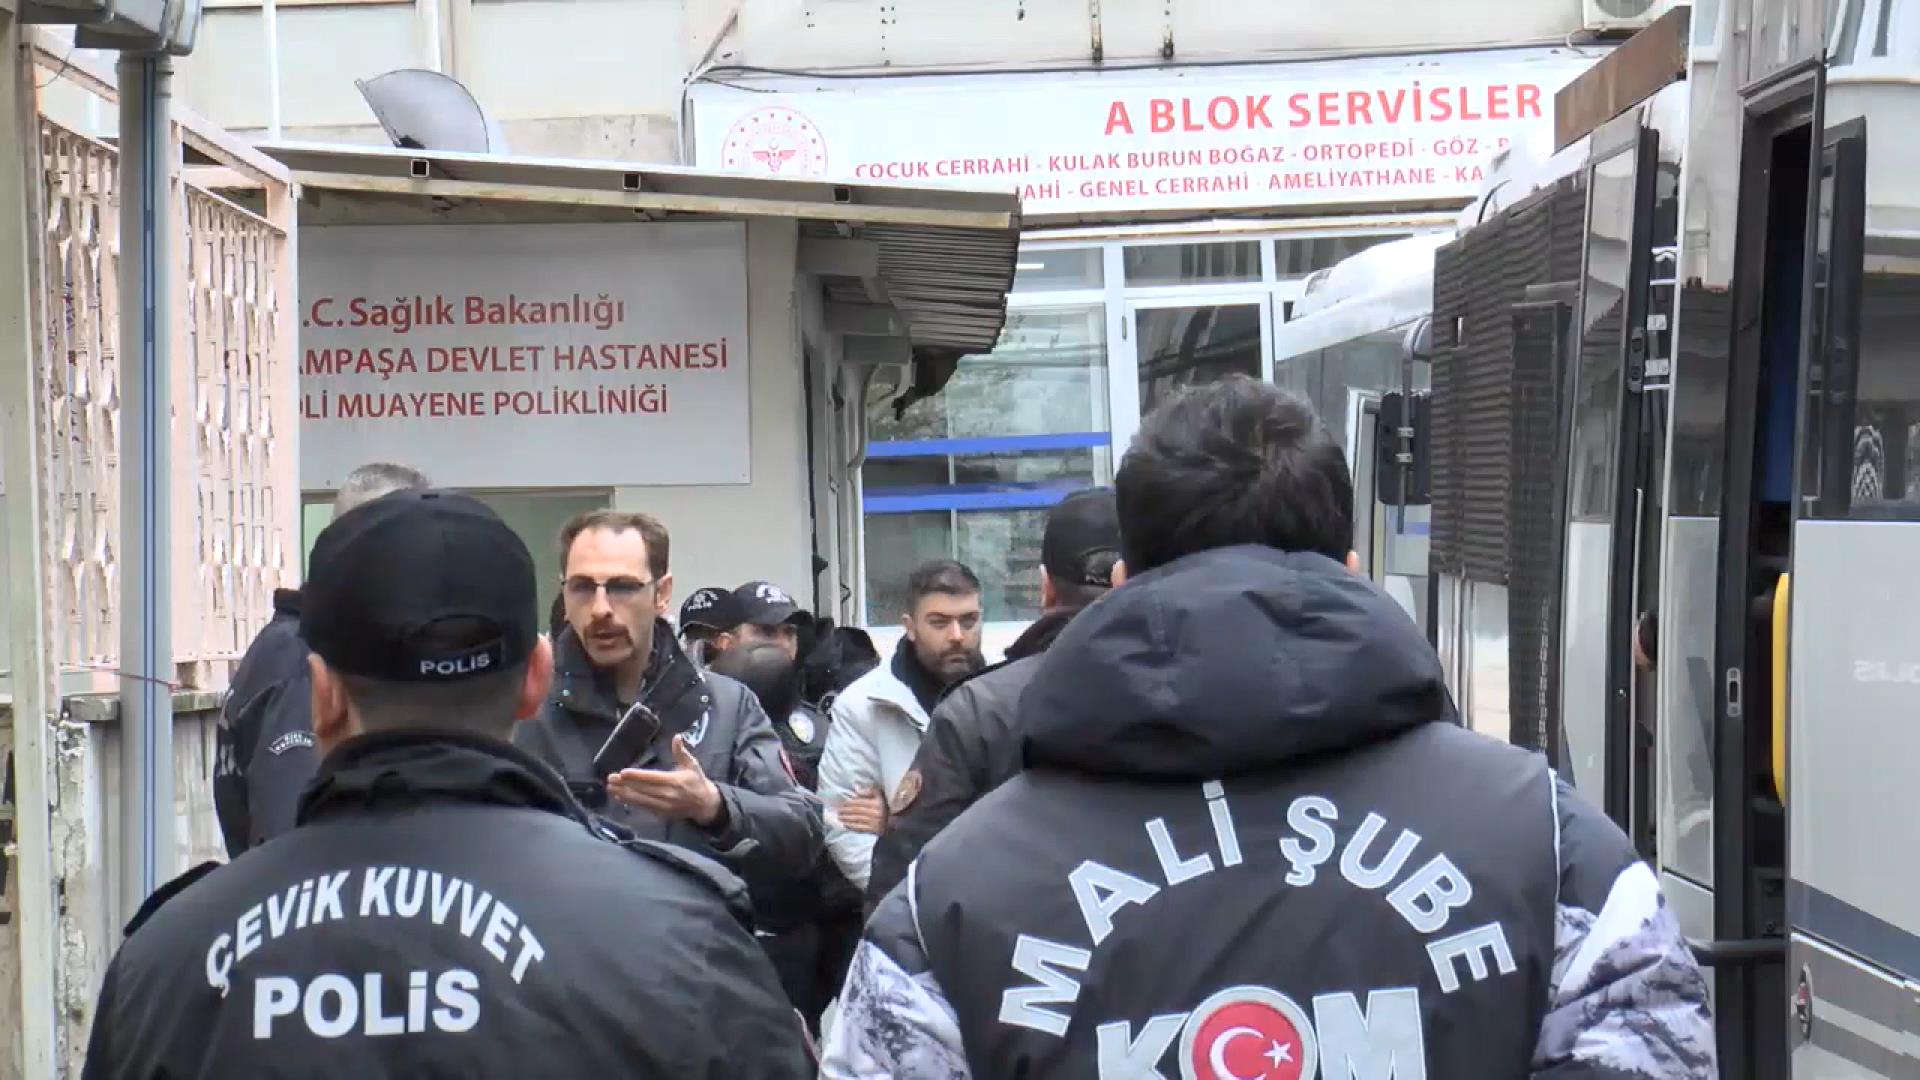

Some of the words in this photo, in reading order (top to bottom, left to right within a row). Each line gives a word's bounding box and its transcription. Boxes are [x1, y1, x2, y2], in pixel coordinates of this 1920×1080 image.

[1103, 100, 1134, 136] A
[1149, 94, 1273, 133] BLOK
[1288, 80, 1543, 128] SERVİSLER
[935, 154, 1029, 176] CERRAHİ
[1049, 152, 1120, 172] KULAK
[1127, 149, 1201, 169] BURUN
[1210, 144, 1285, 165] BOĞAZ
[1303, 137, 1414, 161] ORTOPEDİ
[1433, 135, 1479, 156] GÖZ
[1022, 179, 1060, 200] AHİ
[1079, 179, 1149, 198] GENEL
[1155, 171, 1249, 194] CERRAHİ
[1268, 166, 1436, 190] AMELİYATHANE
[299, 297, 343, 328] .C.
[349, 294, 455, 334] Sağlık
[464, 293, 625, 331] Bakanlığı
[299, 347, 418, 381] MPAŞA
[427, 345, 545, 373] DEVLET
[553, 337, 727, 371] HASTANESİ
[299, 389, 328, 418] Lİ
[337, 392, 485, 418] MUAYENE
[494, 383, 667, 416] POLİKLİNİĞİ
[359, 865, 546, 985] KUVVET
[998, 779, 1244, 1038] MALİ
[1279, 795, 1517, 994] ŞUBE
